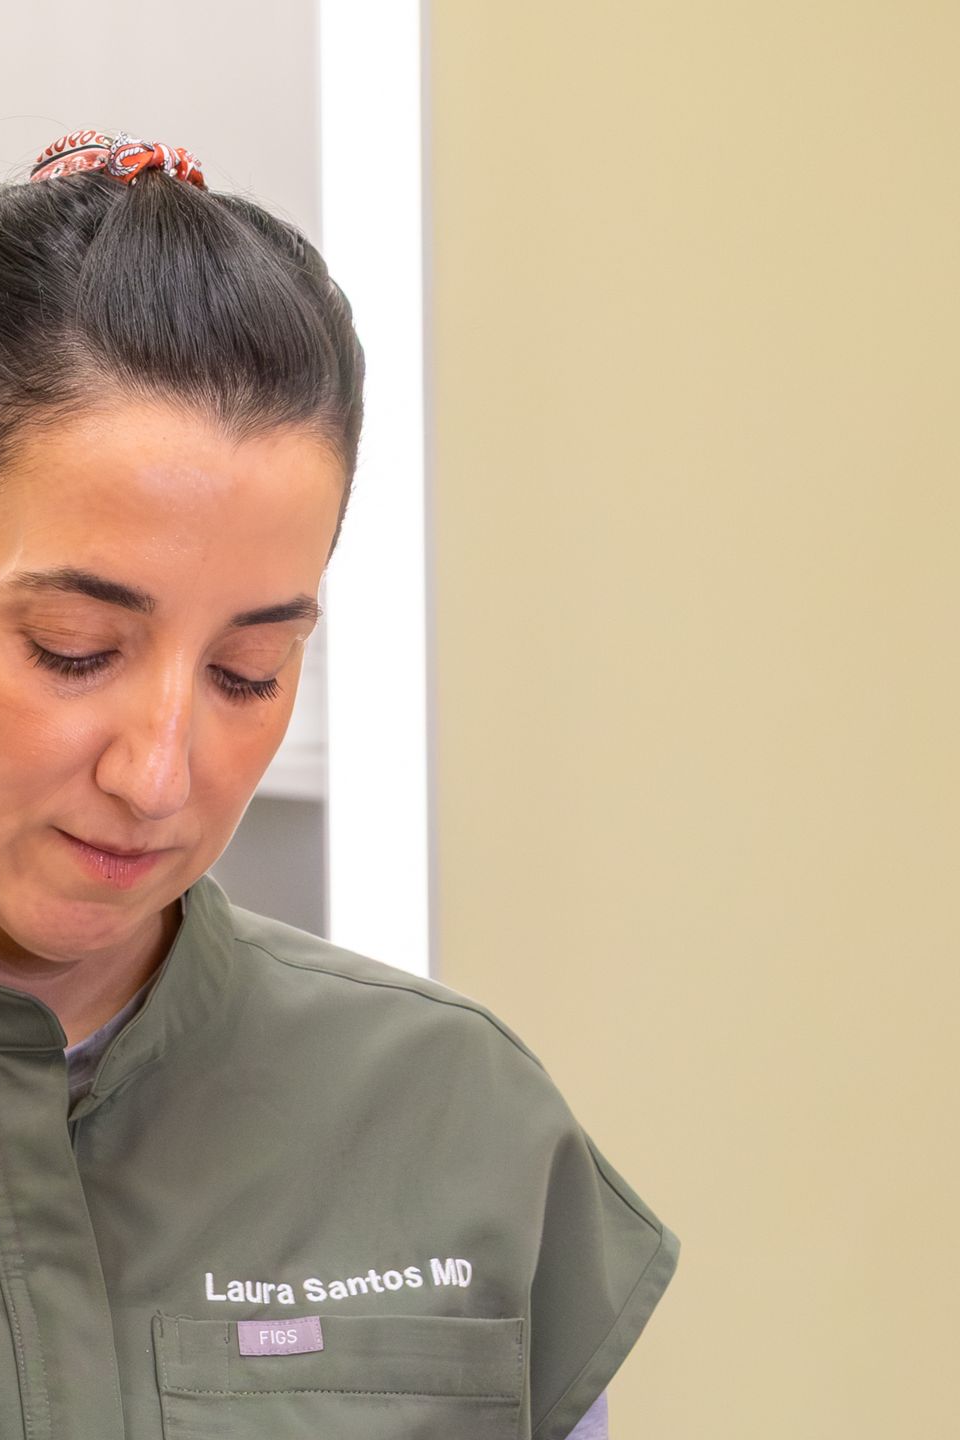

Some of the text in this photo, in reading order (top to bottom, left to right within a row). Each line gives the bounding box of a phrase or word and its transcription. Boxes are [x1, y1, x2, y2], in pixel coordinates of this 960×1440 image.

[205, 1257, 473, 1304] Laura Santos MD
[259, 1329, 298, 1345] FIGS
